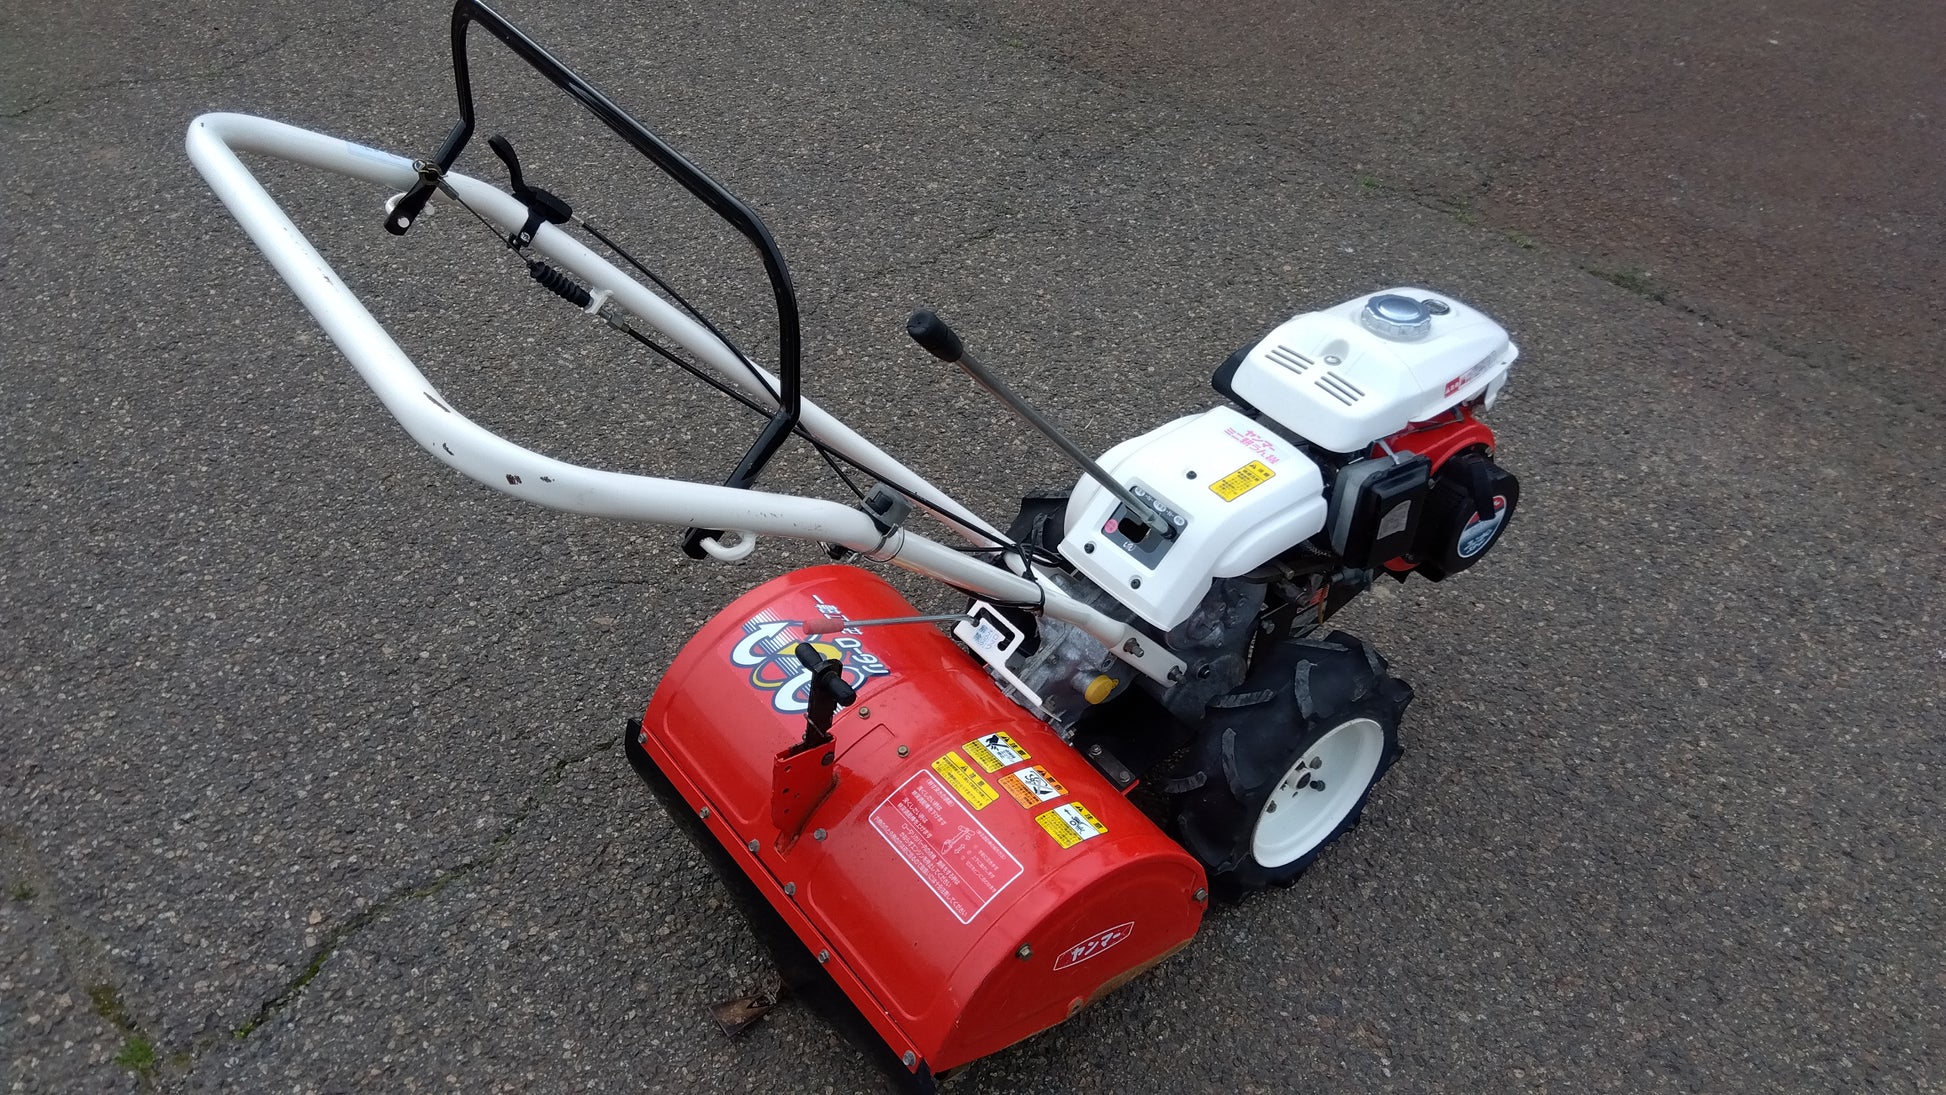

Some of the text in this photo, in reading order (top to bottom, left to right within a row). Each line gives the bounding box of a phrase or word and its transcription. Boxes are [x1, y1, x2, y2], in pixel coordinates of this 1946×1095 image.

[1245, 429, 1276, 452] ヤンマー
[1070, 932, 1121, 962] ヤンマー
